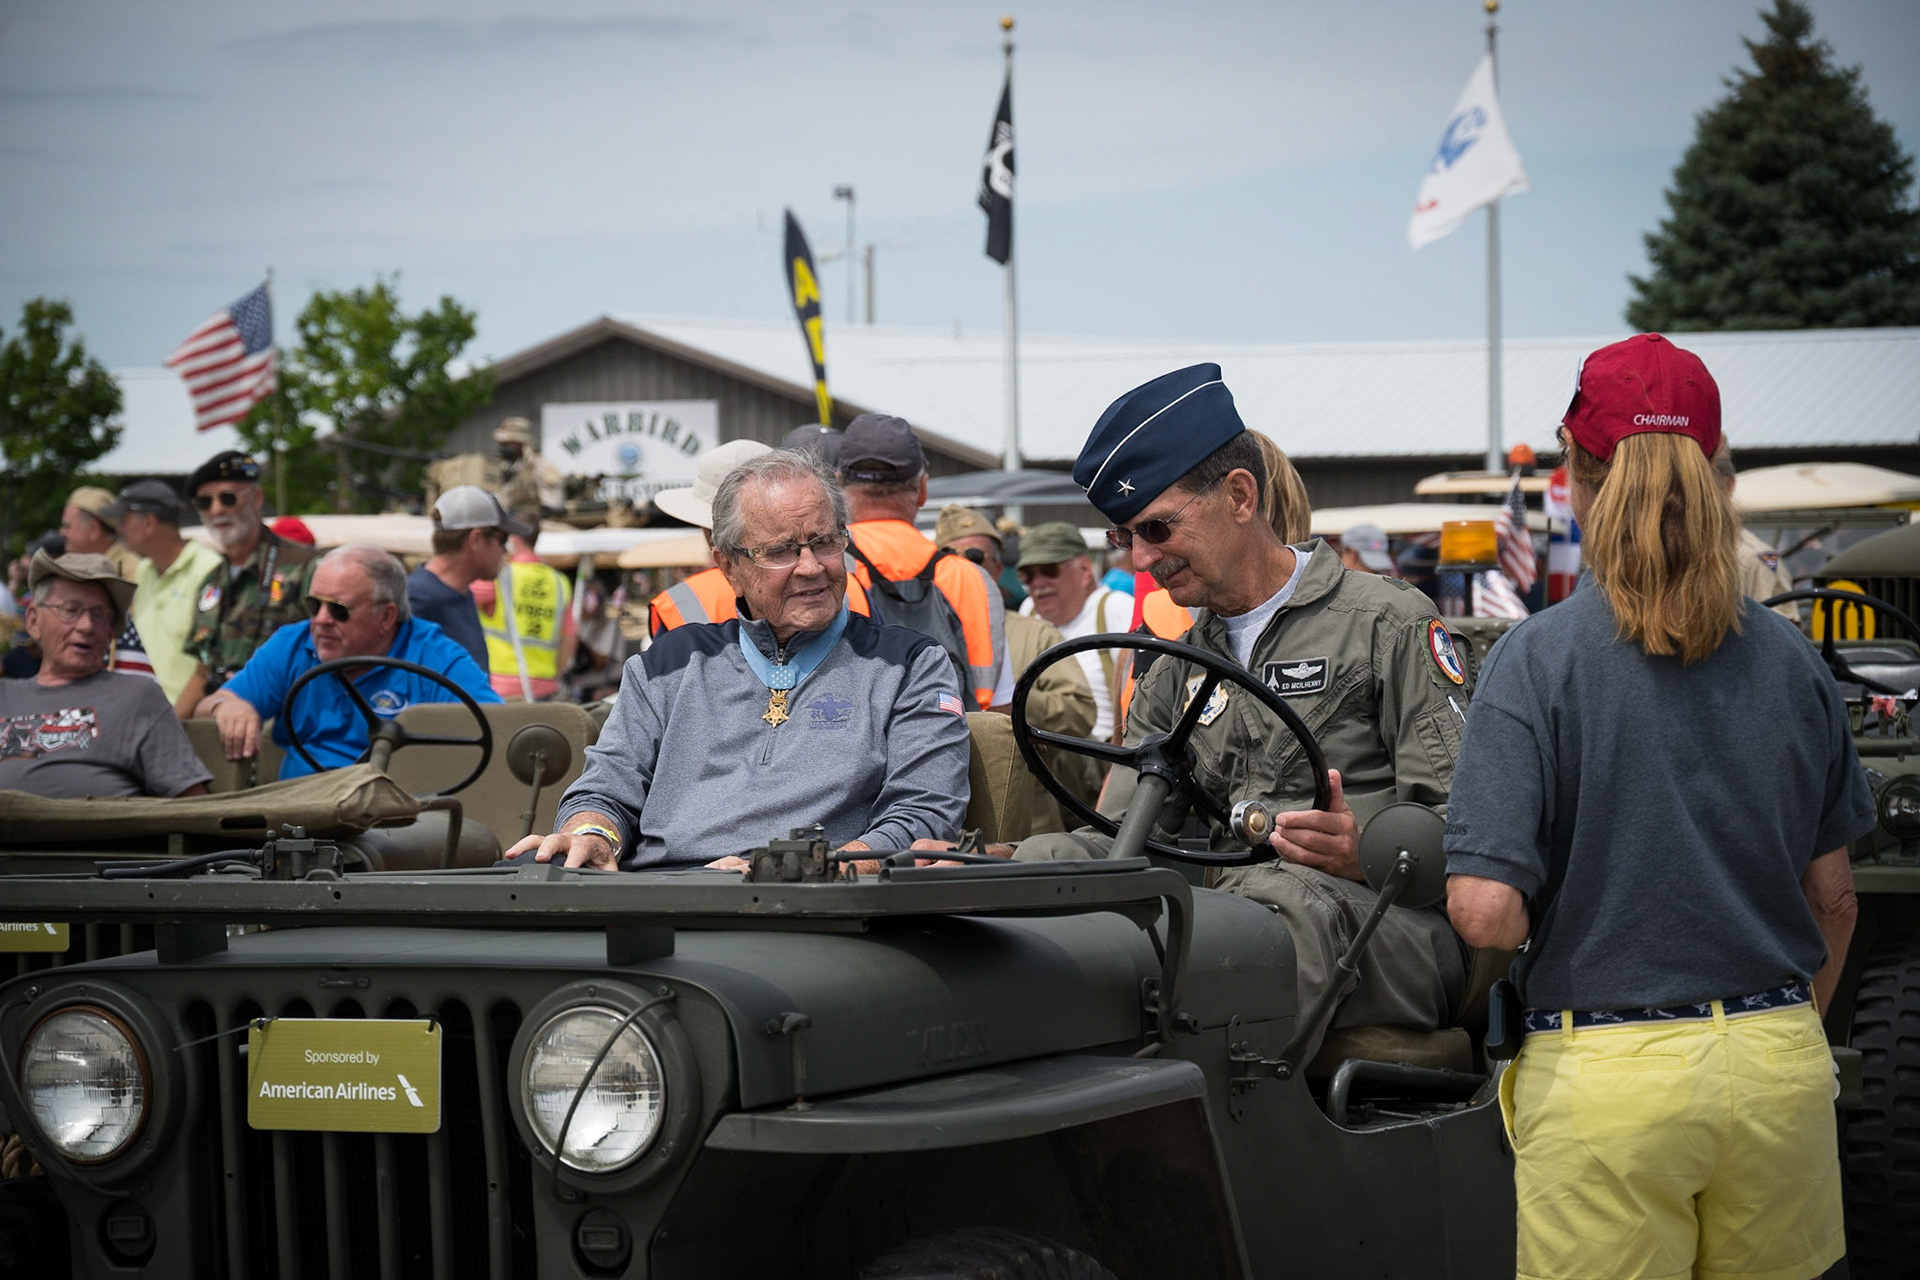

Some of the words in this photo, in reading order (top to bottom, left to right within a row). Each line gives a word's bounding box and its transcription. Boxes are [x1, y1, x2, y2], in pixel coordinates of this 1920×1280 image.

[1633, 413, 1690, 427] CHAIRMAN
[561, 409, 701, 457] WARBIRD
[1281, 682, 1290, 690] ED
[304, 1049, 364, 1065] Sponsored
[366, 1051, 380, 1066] by
[259, 1081, 334, 1099] American
[335, 1082, 397, 1101] Airlines
